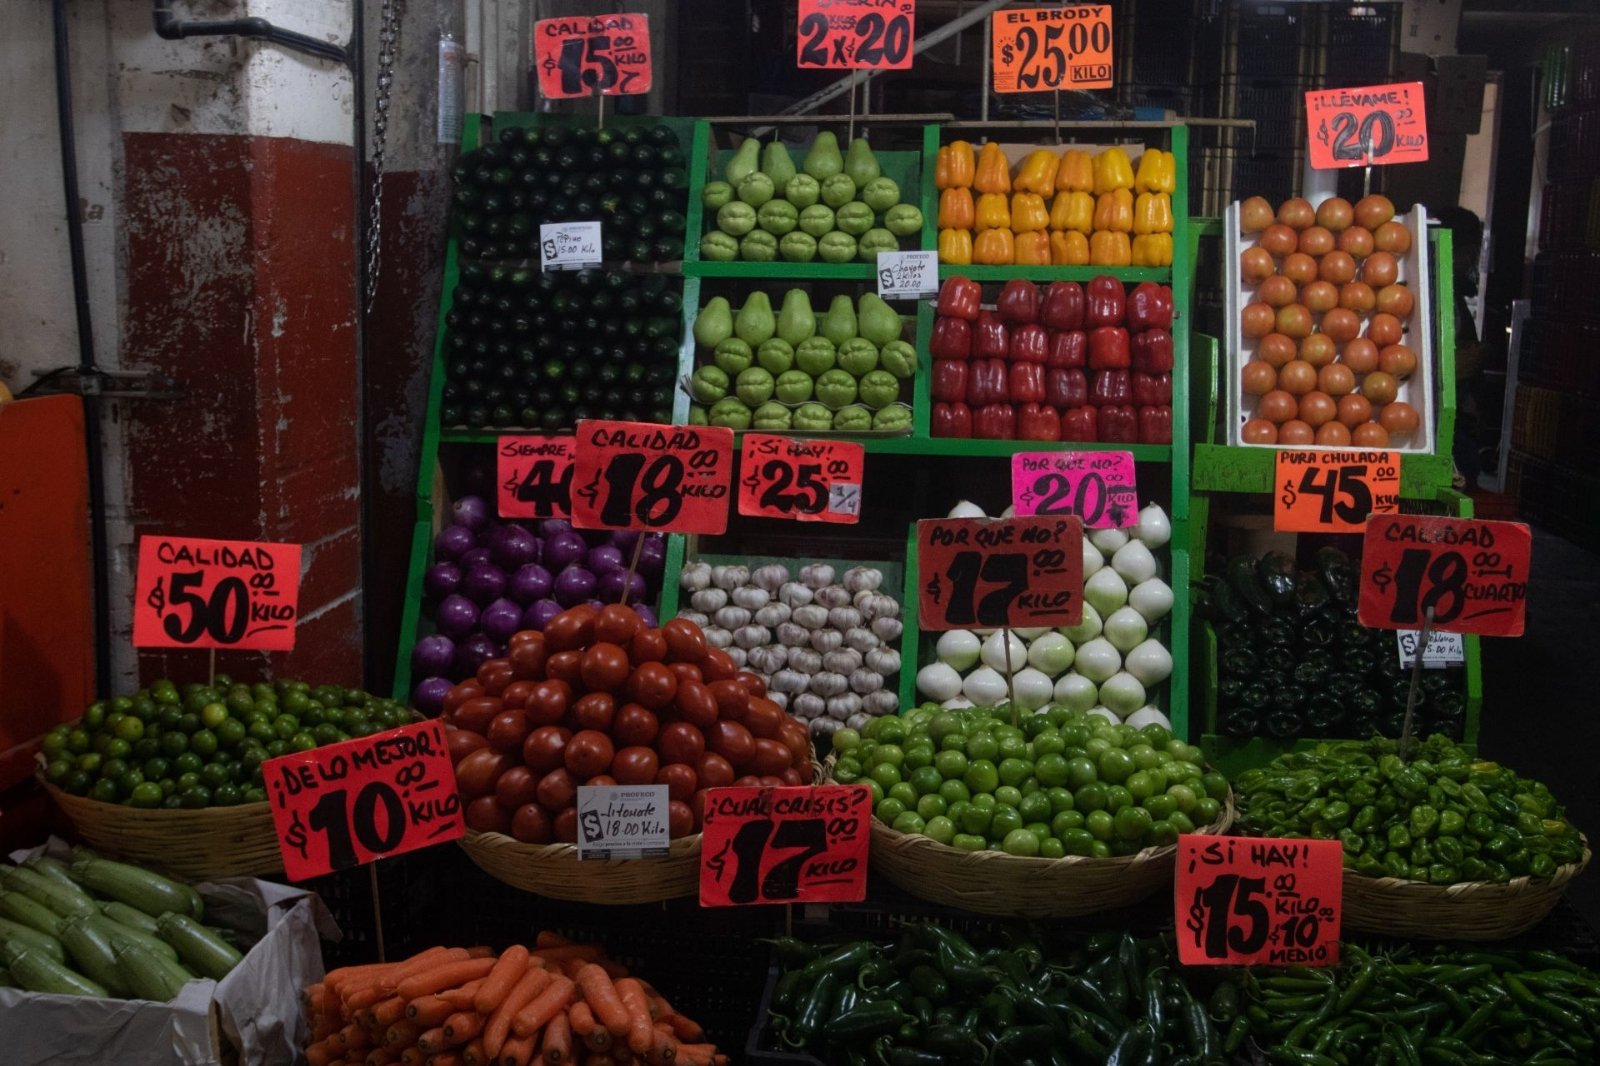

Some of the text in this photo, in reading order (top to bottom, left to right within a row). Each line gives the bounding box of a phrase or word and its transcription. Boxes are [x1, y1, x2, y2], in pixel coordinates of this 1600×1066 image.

[1007, 8, 1104, 24] EL BRODY
[1074, 66, 1107, 80] KILO
[591, 429, 700, 450] CALIDAD
[1022, 458, 1050, 471] POR
[1280, 449, 1389, 464] PURA CHULADA
[682, 484, 727, 499] KILO
[930, 525, 968, 548] POR
[974, 525, 1015, 549] QUE
[157, 541, 274, 571] CALIDAD
[1017, 590, 1070, 610] KILO
[250, 602, 295, 622] KILO
[317, 755, 348, 781] LO
[351, 726, 446, 771] MEJOR!
[407, 793, 460, 826] KILO
[1251, 845, 1309, 869] HAY!
[804, 859, 858, 878] KILO
[1275, 897, 1320, 915] KILO
[1269, 945, 1327, 963] MEDIO
